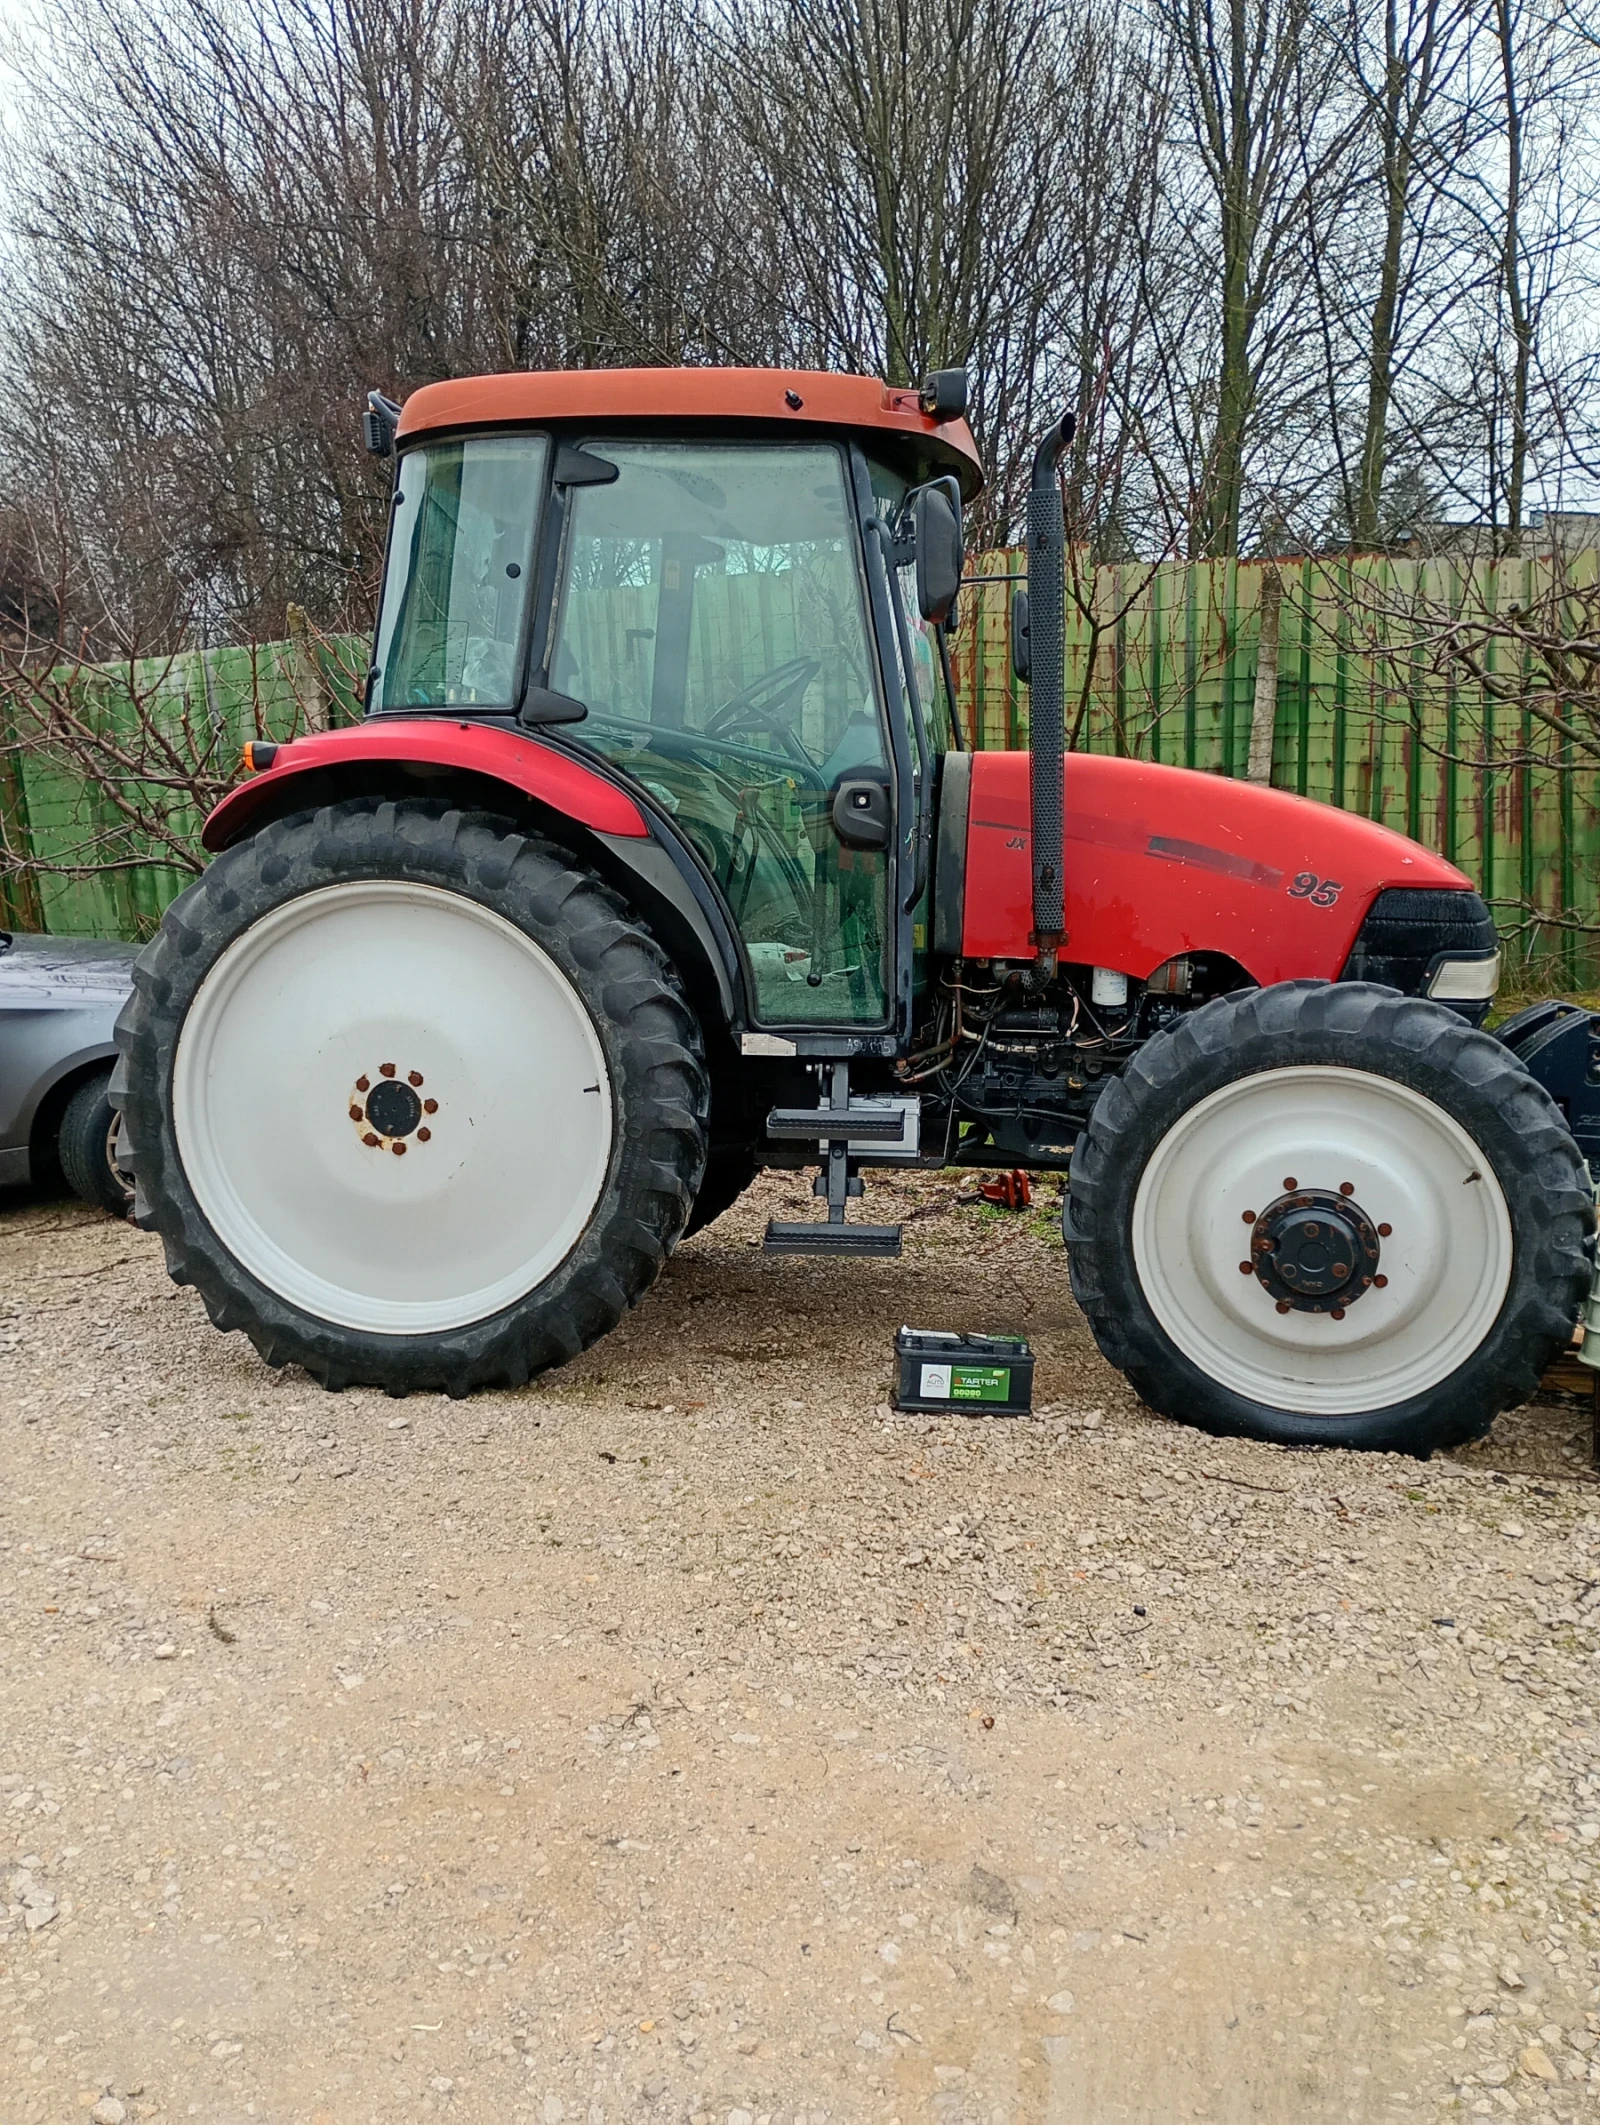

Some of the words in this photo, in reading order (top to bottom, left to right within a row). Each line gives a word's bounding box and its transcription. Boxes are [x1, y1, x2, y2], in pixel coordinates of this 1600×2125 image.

[1004, 837, 1028, 850] JX
[333, 845, 467, 877] ALLIANCE
[1288, 872, 1343, 907] 95
